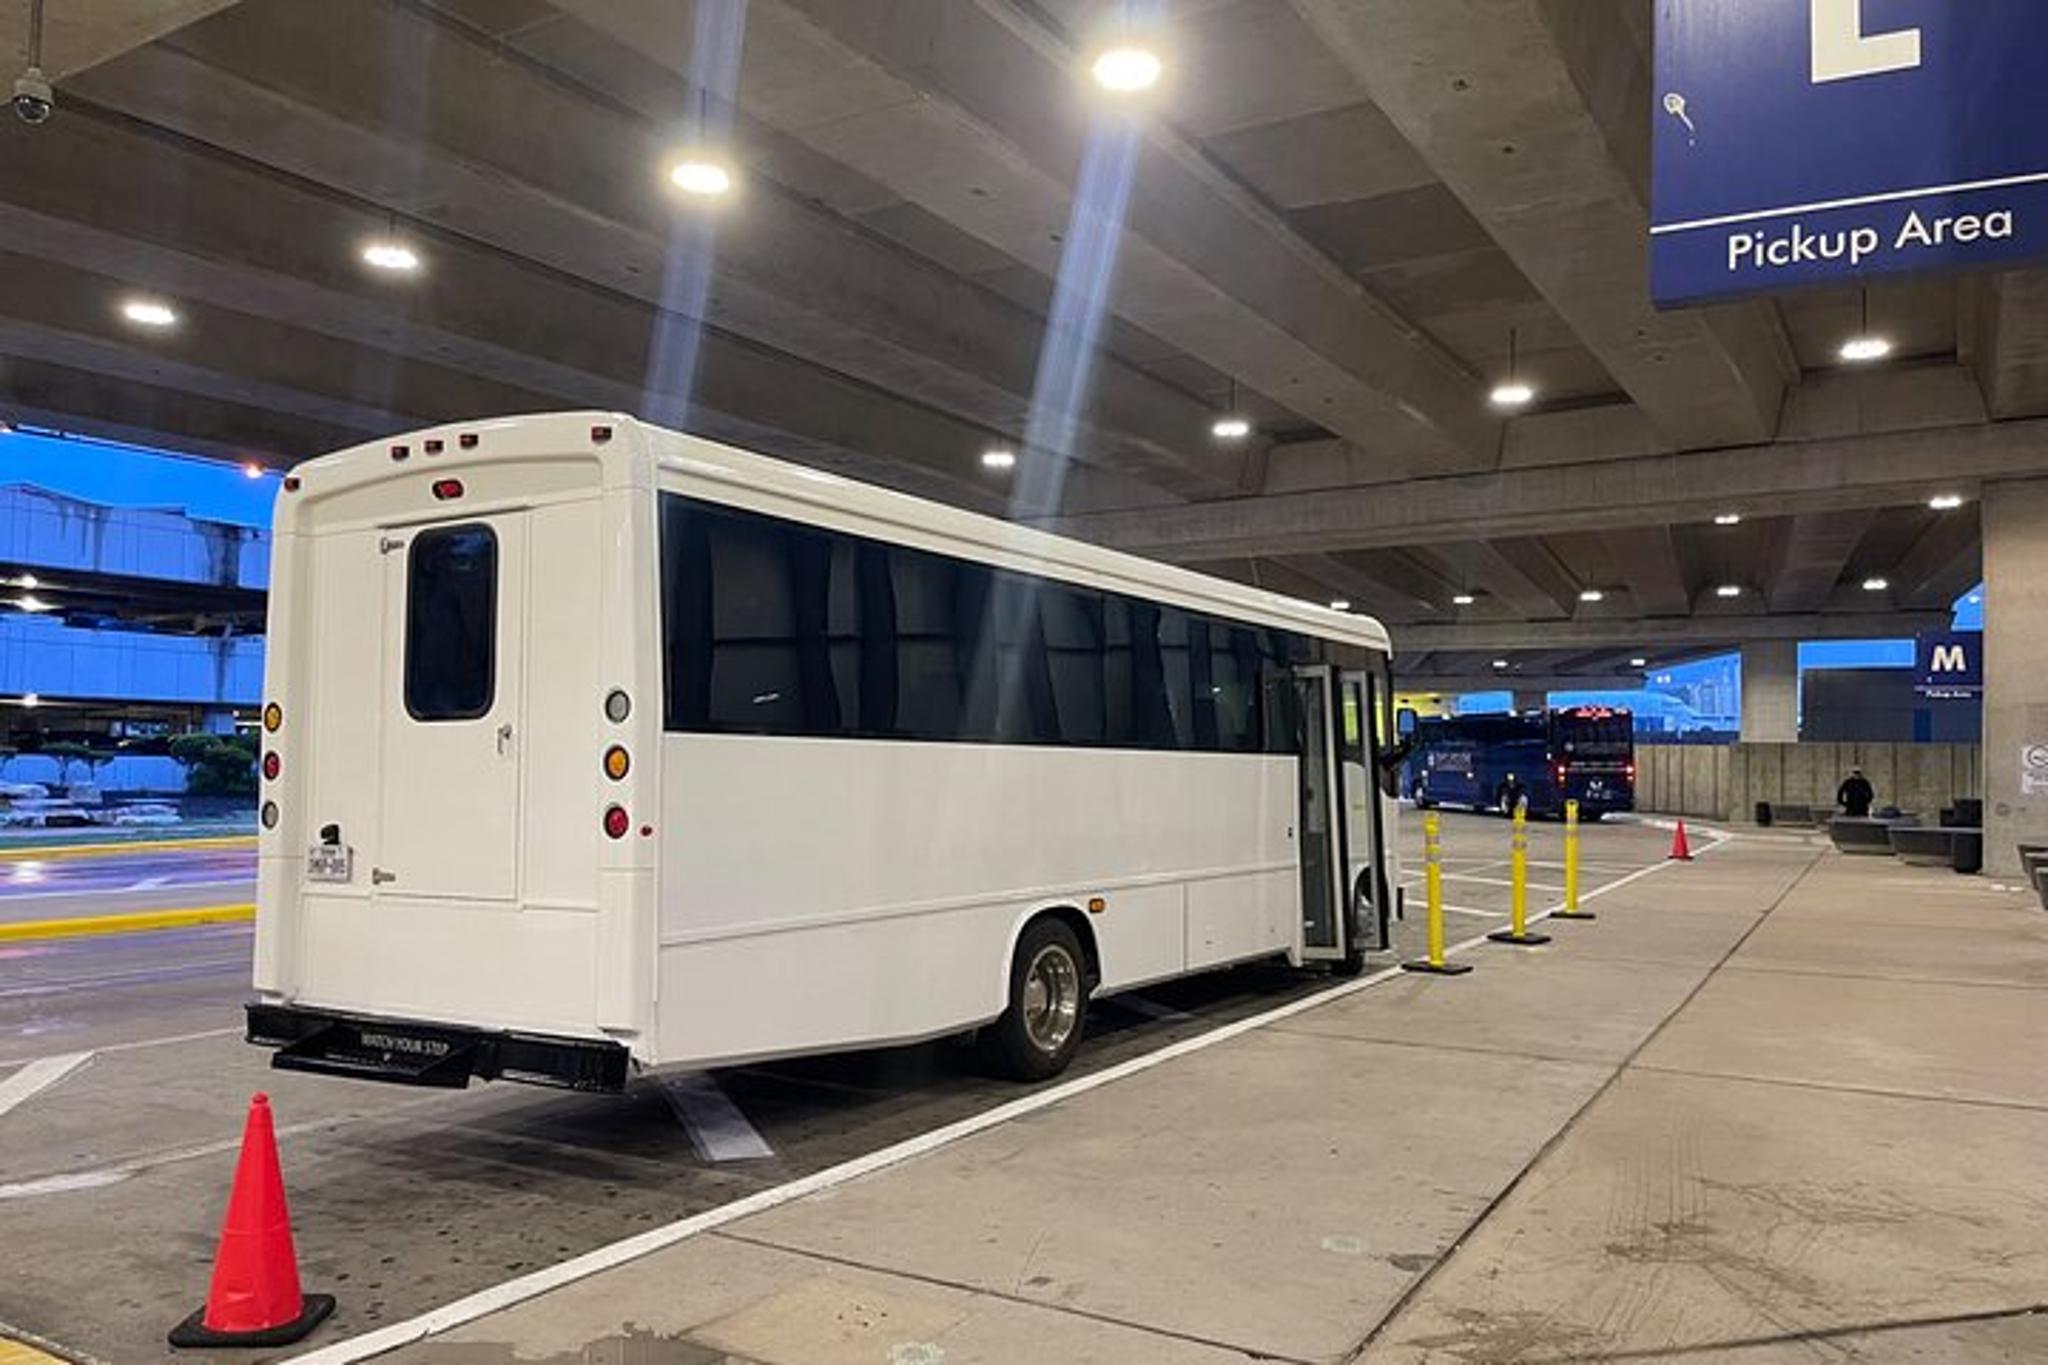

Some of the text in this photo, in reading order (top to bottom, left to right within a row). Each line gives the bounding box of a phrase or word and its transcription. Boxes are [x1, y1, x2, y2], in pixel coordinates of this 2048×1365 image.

[1728, 210, 2012, 270] Pickup Area
[1931, 644, 1966, 672] M
